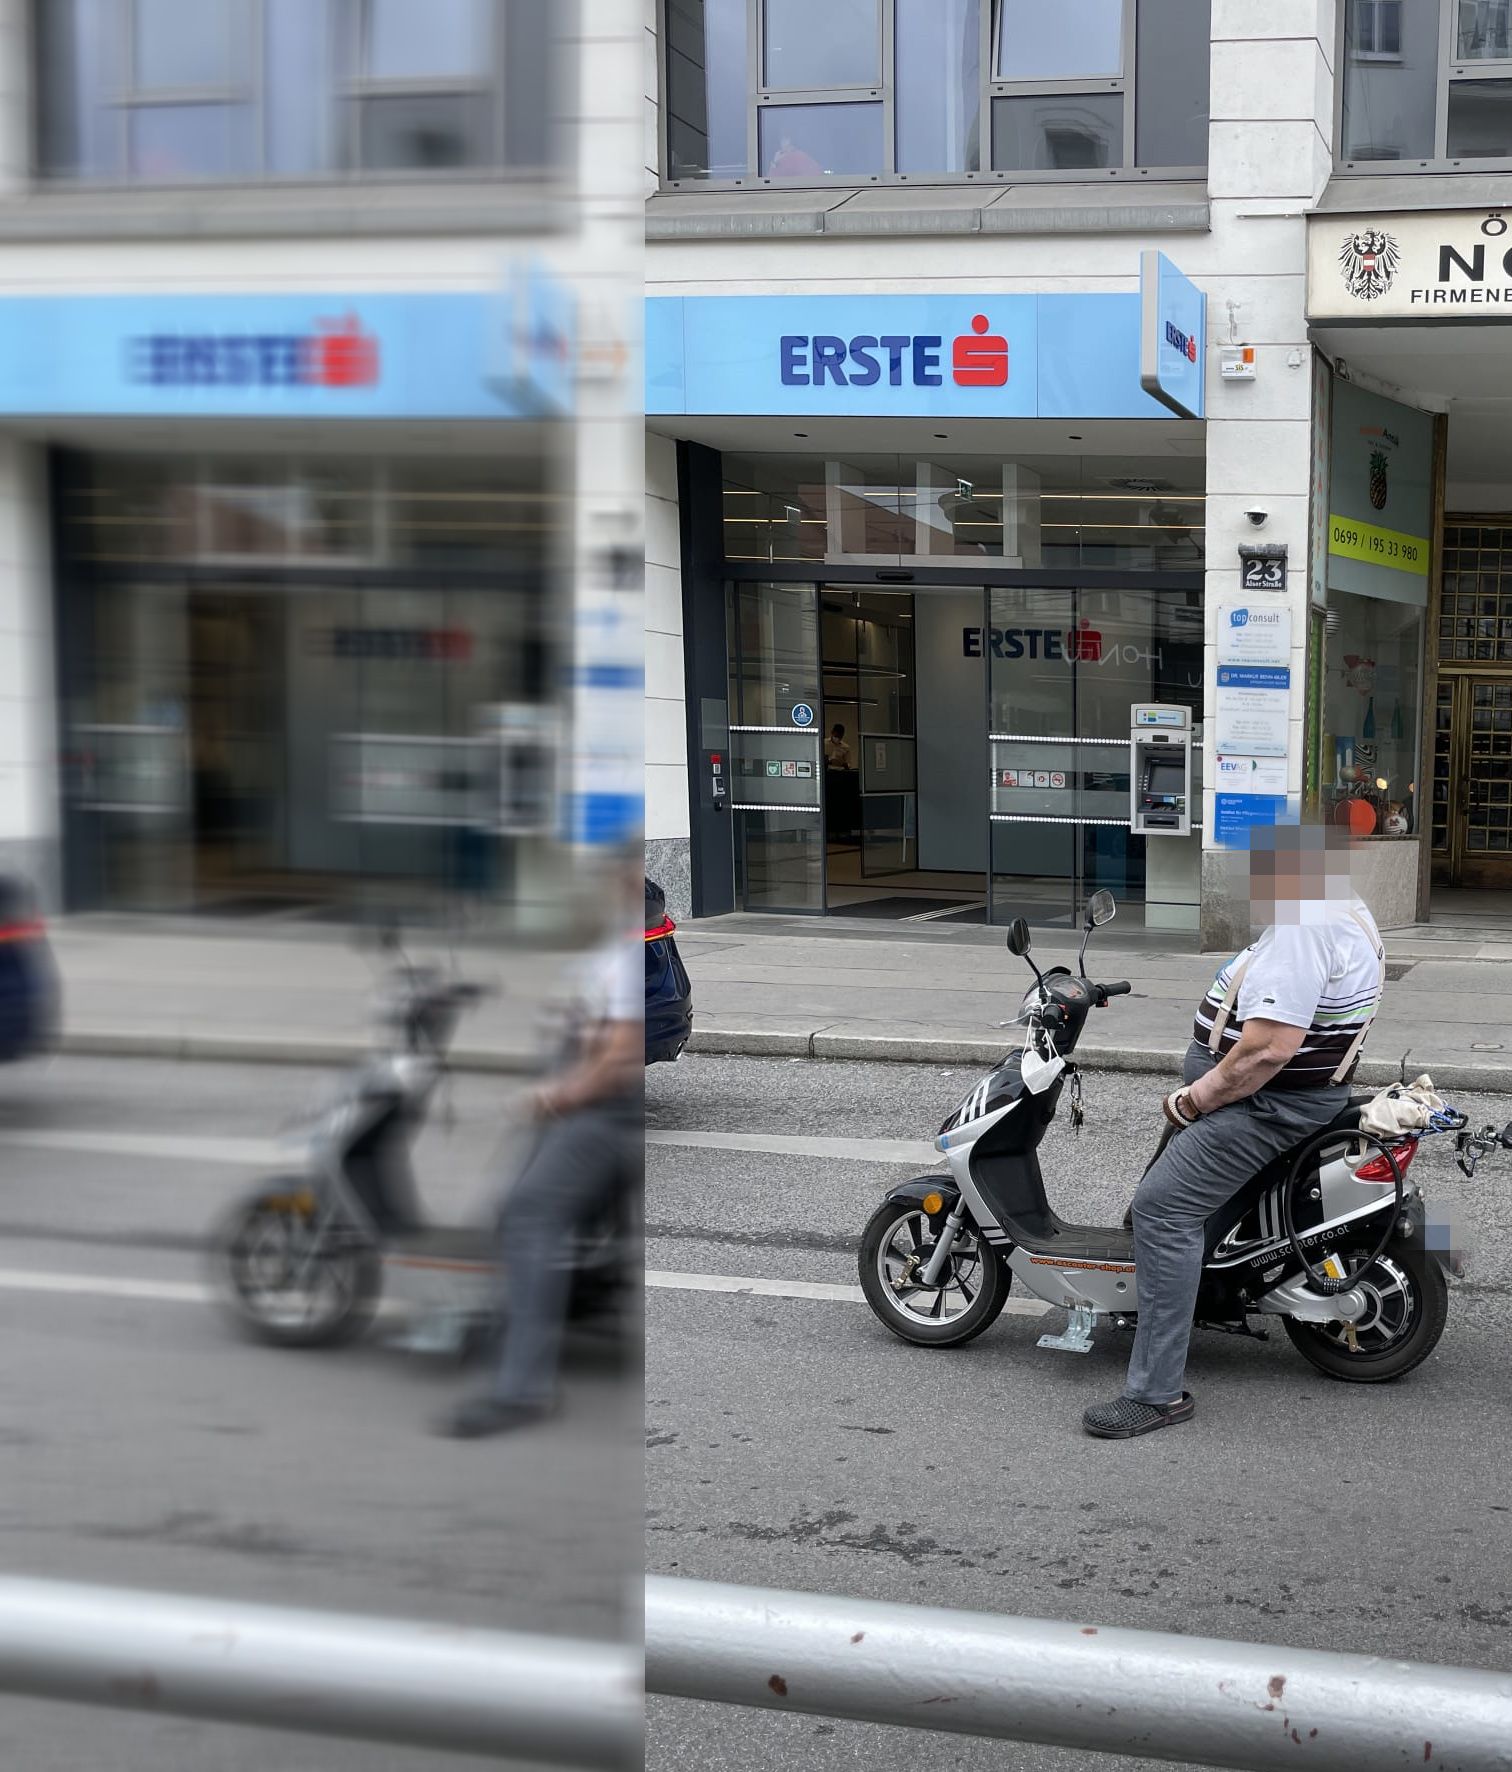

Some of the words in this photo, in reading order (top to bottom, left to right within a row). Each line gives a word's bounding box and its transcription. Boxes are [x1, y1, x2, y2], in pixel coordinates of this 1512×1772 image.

[1166, 320, 1188, 357] ERSTE
[780, 335, 943, 387] ERSTE
[1334, 527, 1358, 546] 0699
[1369, 535, 1384, 553] 195
[1387, 541, 1399, 556] 33
[1401, 545, 1418, 561] 980
[1246, 559, 1282, 581] 23
[962, 627, 1062, 660] ERSTE
